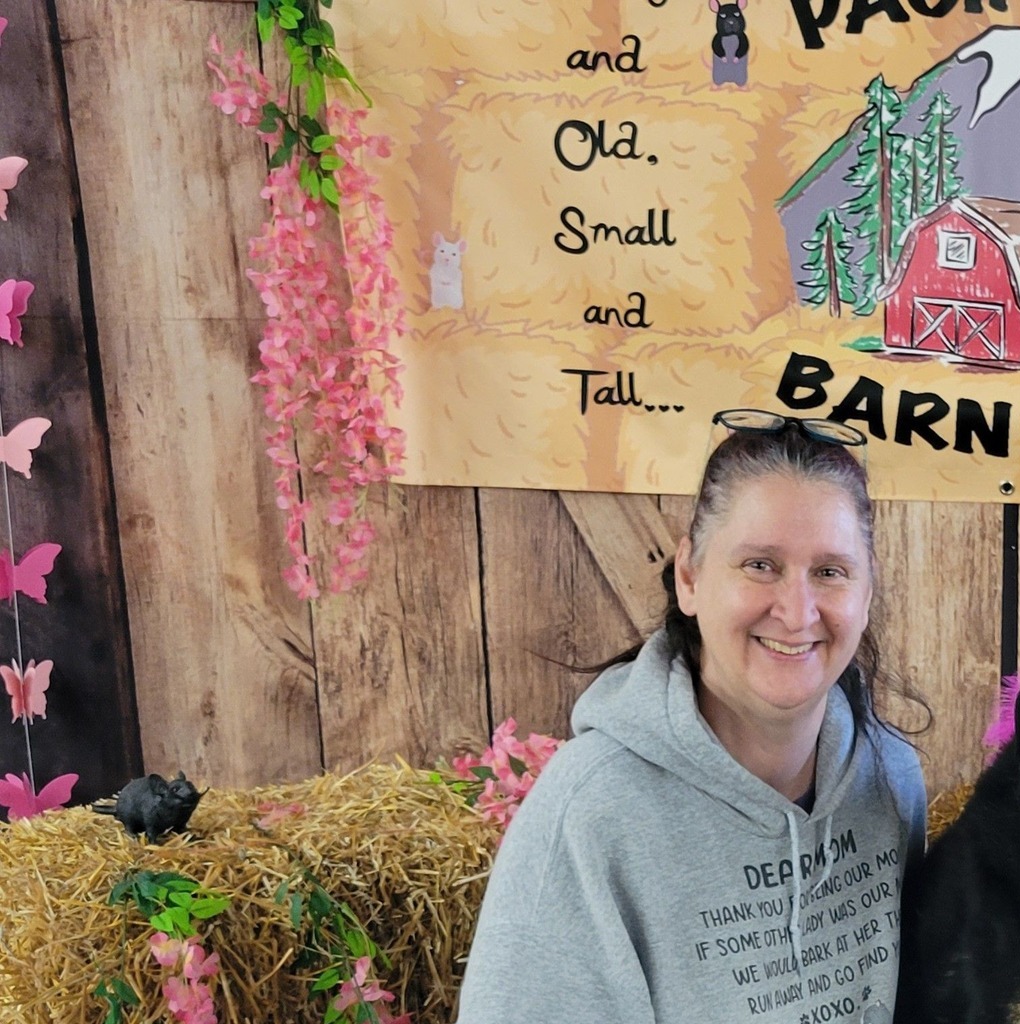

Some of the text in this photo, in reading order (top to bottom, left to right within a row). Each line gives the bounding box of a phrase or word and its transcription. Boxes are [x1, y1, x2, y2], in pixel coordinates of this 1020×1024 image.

[566, 34, 646, 73] and
[554, 120, 658, 171] Old,
[554, 206, 676, 254] Small
[583, 292, 653, 328] and
[776, 352, 1012, 457] BARN
[699, 902, 757, 929] THANK
[757, 898, 784, 917] YOU
[844, 862, 874, 887] OUR
[876, 848, 898, 871] MO
[743, 853, 813, 890] DEAR
[695, 941, 709, 961] IF
[716, 931, 762, 957] SOME
[828, 899, 857, 924] WAS
[861, 881, 893, 908] OUR
[732, 963, 760, 986] WE
[763, 954, 798, 981] WOULD
[801, 942, 833, 968] BARK
[836, 934, 850, 956] AT
[853, 918, 881, 947] HER
[747, 995, 773, 1016] RUN
[775, 982, 804, 1008] AWAY
[807, 973, 831, 998] AND
[834, 964, 855, 987] GO
[857, 946, 889, 975] FIND
